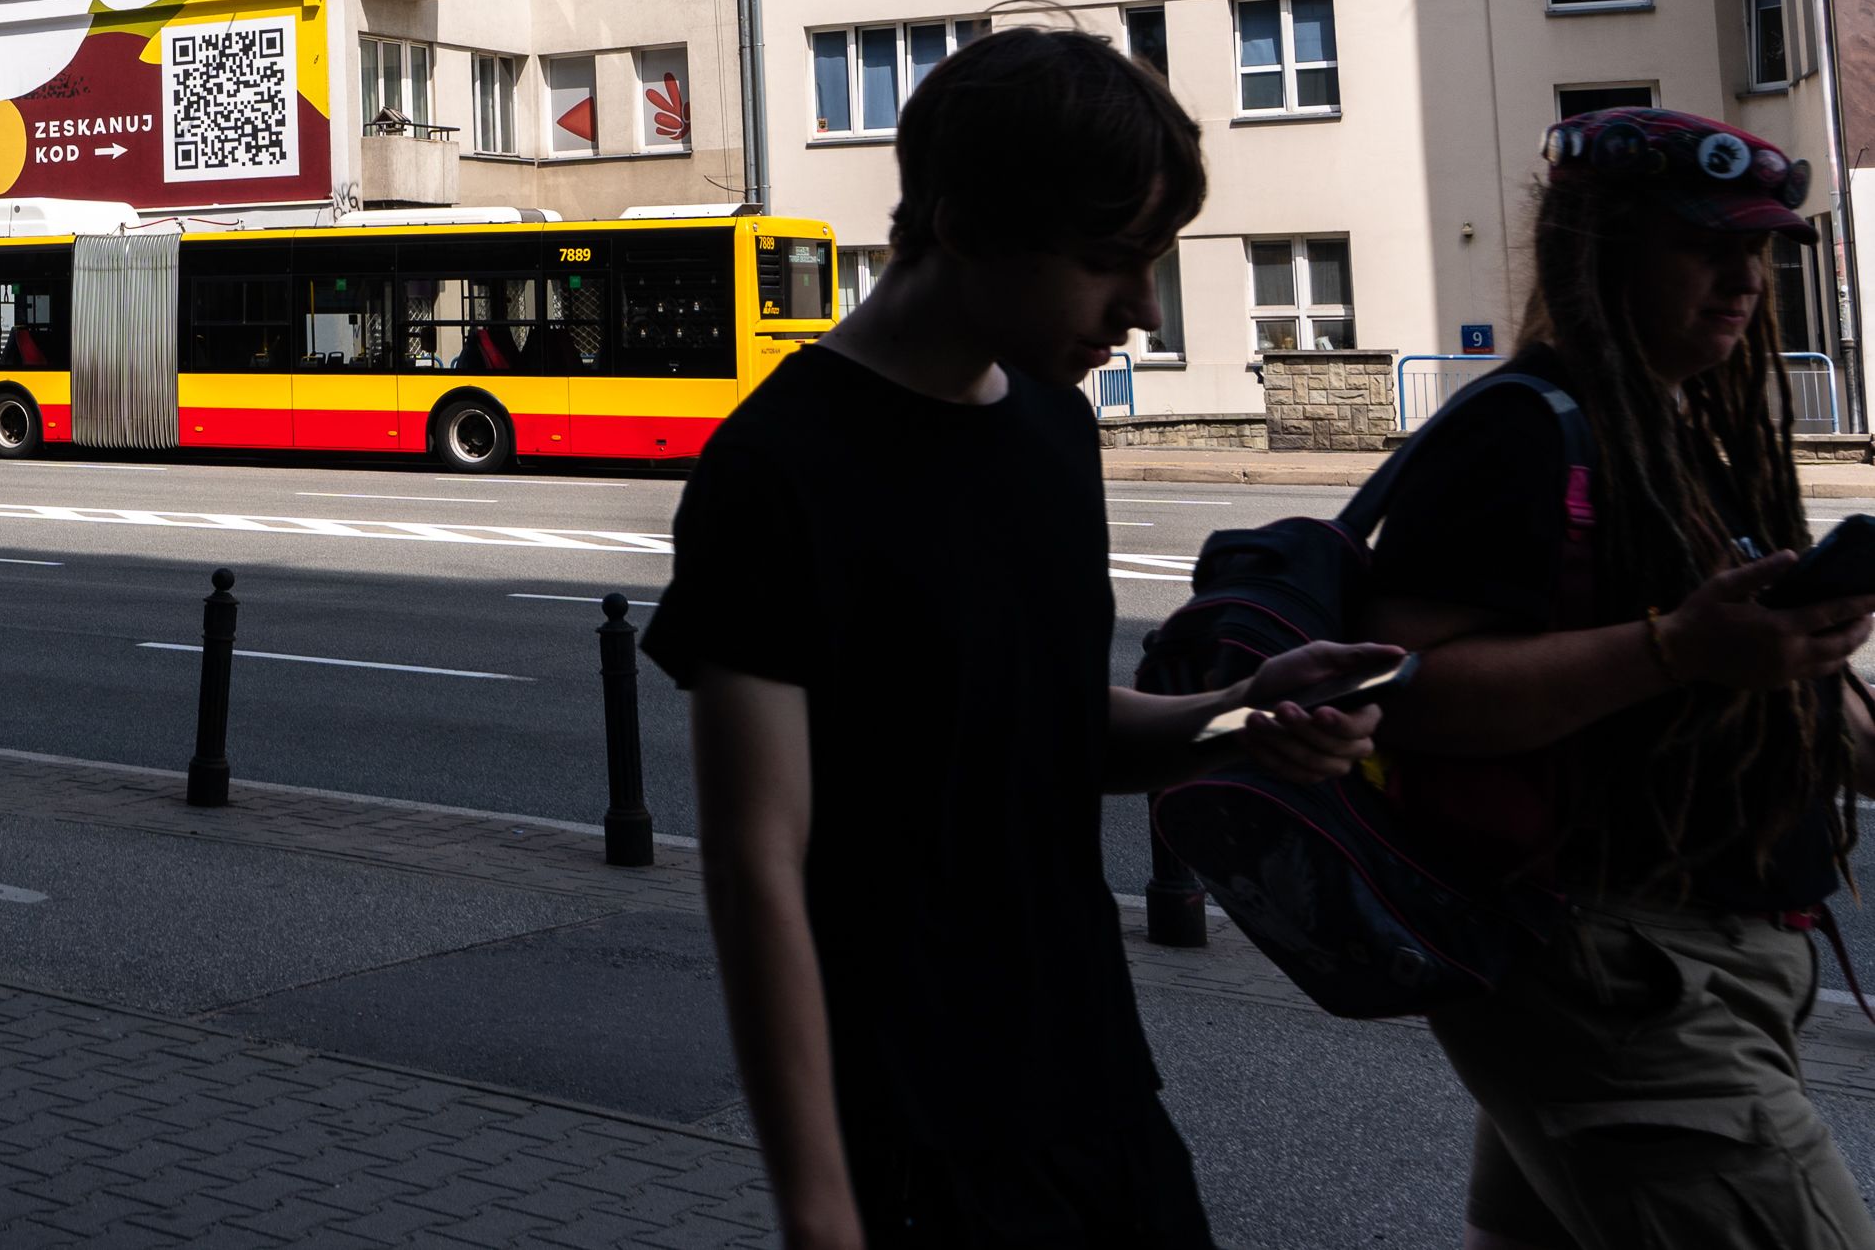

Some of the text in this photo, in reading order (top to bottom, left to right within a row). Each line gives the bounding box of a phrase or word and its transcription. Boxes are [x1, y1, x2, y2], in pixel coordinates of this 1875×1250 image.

[34, 114, 153, 139] ZESKANUJ
[35, 144, 80, 164] KOD
[758, 236, 775, 250] 7889
[559, 248, 592, 261] 7889
[1472, 331, 1483, 347] 9
